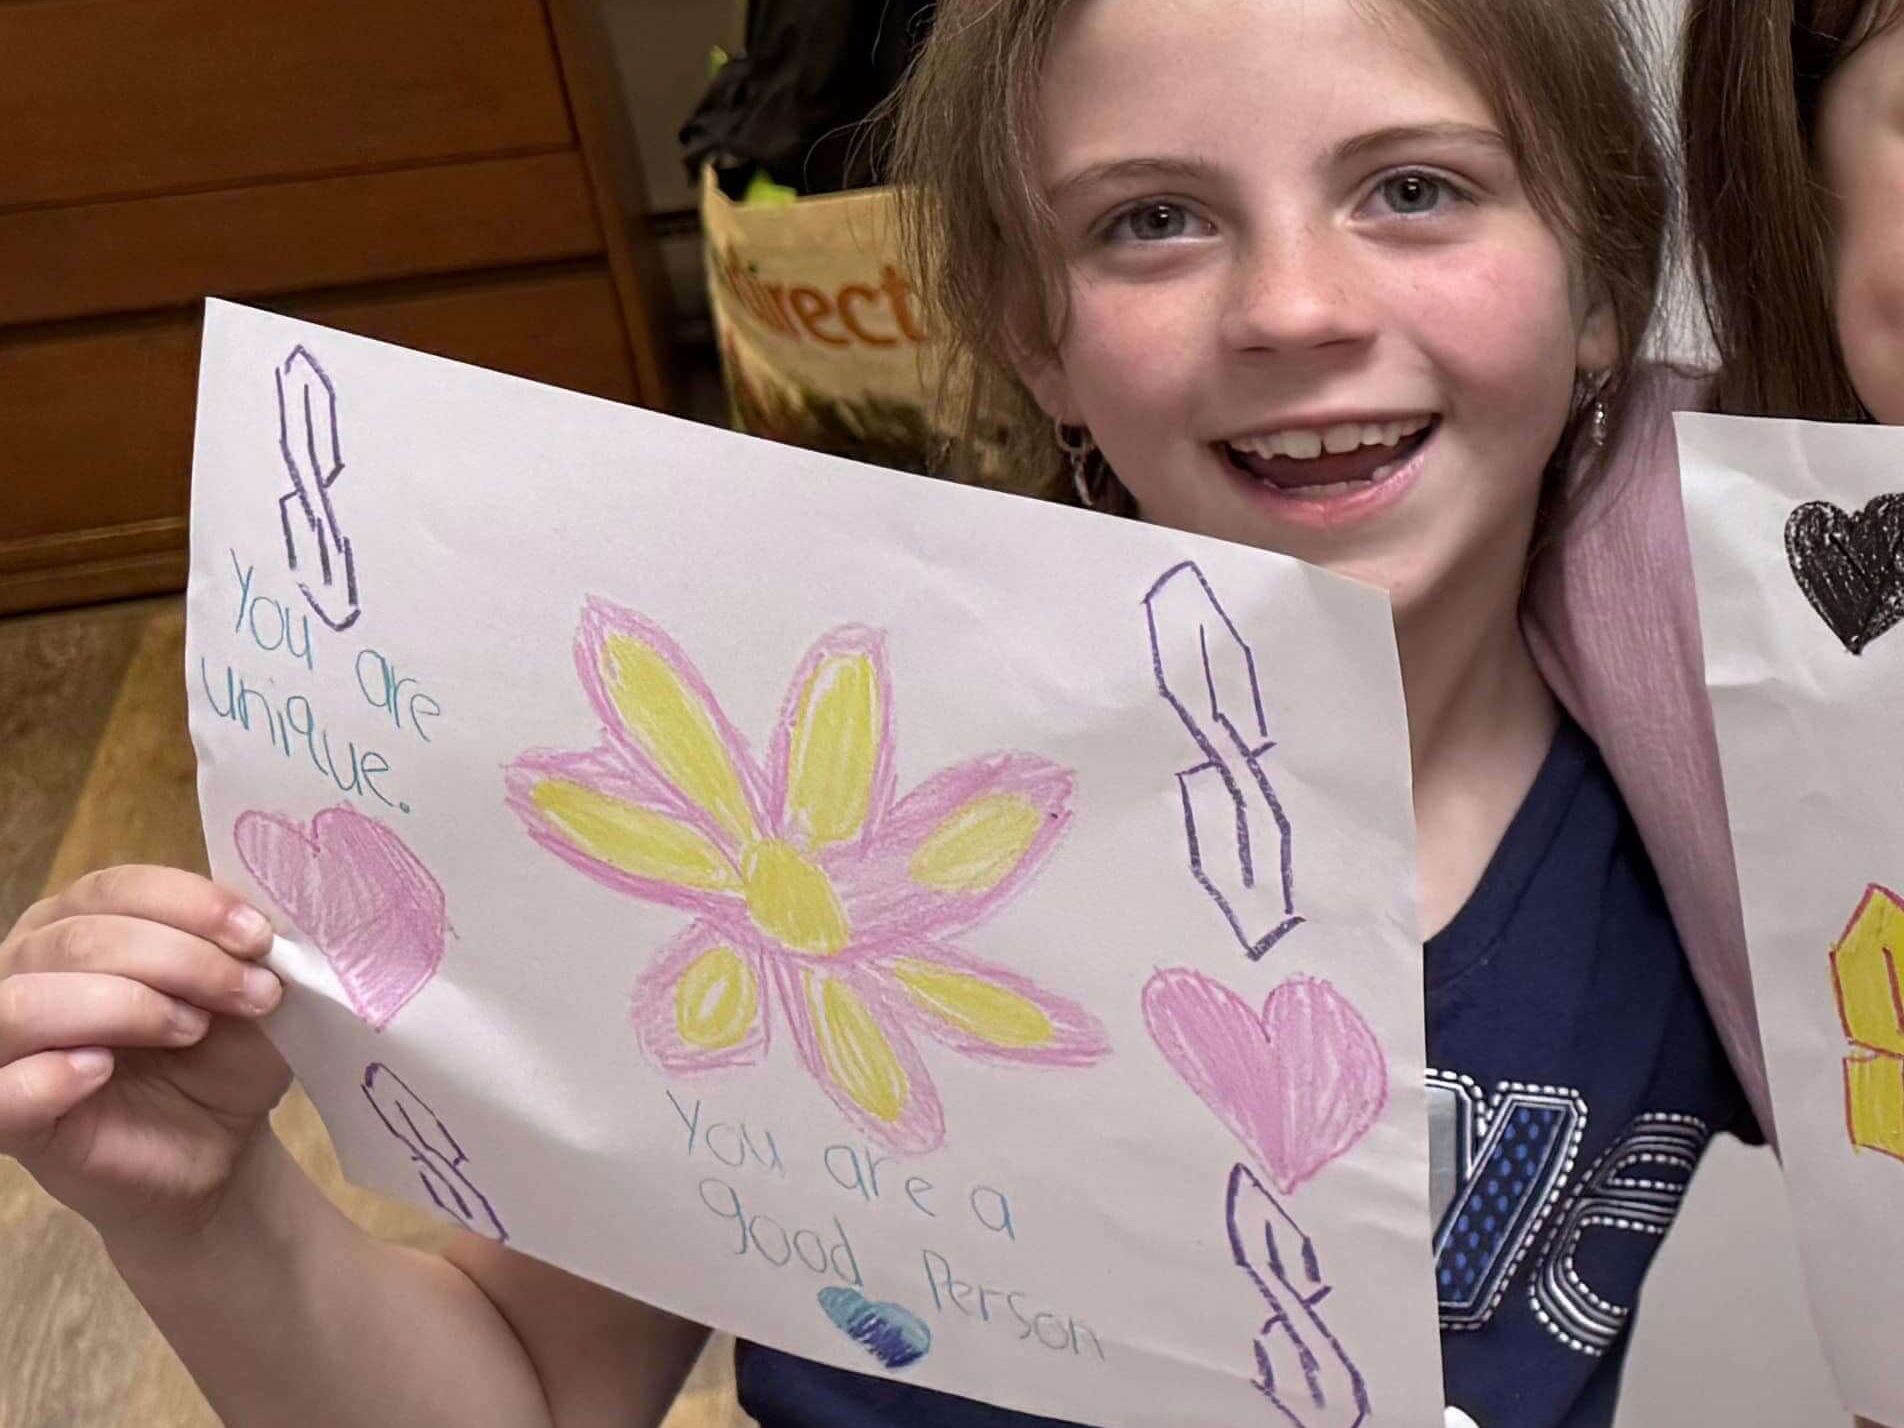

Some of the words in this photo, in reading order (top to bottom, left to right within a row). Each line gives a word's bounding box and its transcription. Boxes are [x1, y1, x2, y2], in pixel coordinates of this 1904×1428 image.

[355, 648, 442, 743] are
[699, 1177, 865, 1288] good
[823, 1144, 938, 1218] are
[968, 1184, 1017, 1242] a
